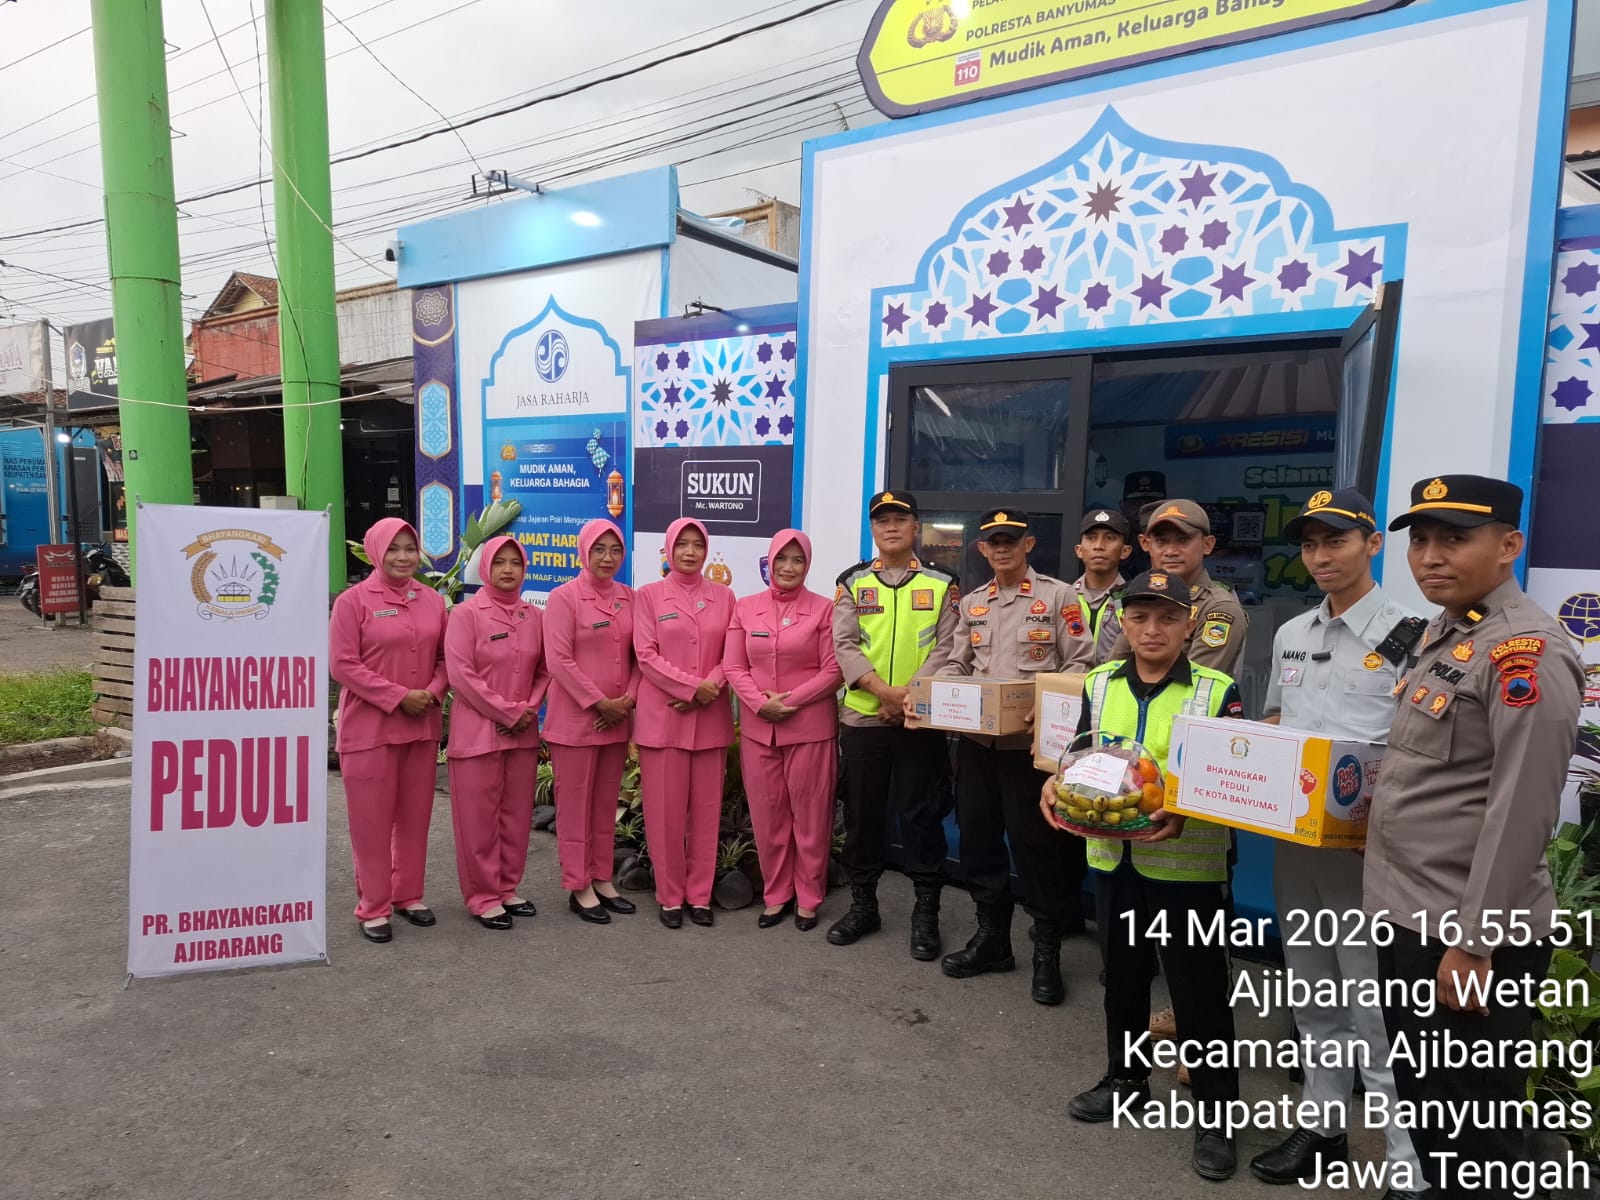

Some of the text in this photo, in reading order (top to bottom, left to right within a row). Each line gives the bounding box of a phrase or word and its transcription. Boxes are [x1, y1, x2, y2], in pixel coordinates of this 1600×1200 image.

[966, 14, 1032, 41] POLRESTA
[989, 40, 1045, 68] Mudik
[1050, 29, 1111, 53] Aman,
[1117, 6, 1209, 39] Keluarga
[957, 65, 978, 81] 110
[516, 391, 590, 409] JASA RAHARJA
[1215, 429, 1309, 448] PRESISI
[519, 463, 576, 475] MUDIK AMAN,
[1246, 464, 1333, 486] Selam
[510, 478, 590, 488] KELUARGA BAHAGIA
[687, 473, 754, 495] SUKUN
[708, 502, 744, 510] WARTONO
[528, 515, 549, 524] Jajaran
[532, 551, 567, 568] FITRI
[1025, 615, 1051, 623] POLRI
[1428, 660, 1466, 685] POLRI
[147, 656, 316, 712] BHAYANGKARI
[1206, 764, 1267, 783] BHAYANGKARI
[150, 735, 310, 832] PEDULI
[1220, 779, 1250, 793] PEDULI
[1193, 787, 1279, 812] PC KOTA BANYUMAS
[142, 900, 313, 936] PR. BHAYANGKARI
[173, 933, 283, 964] AJIBARANG
